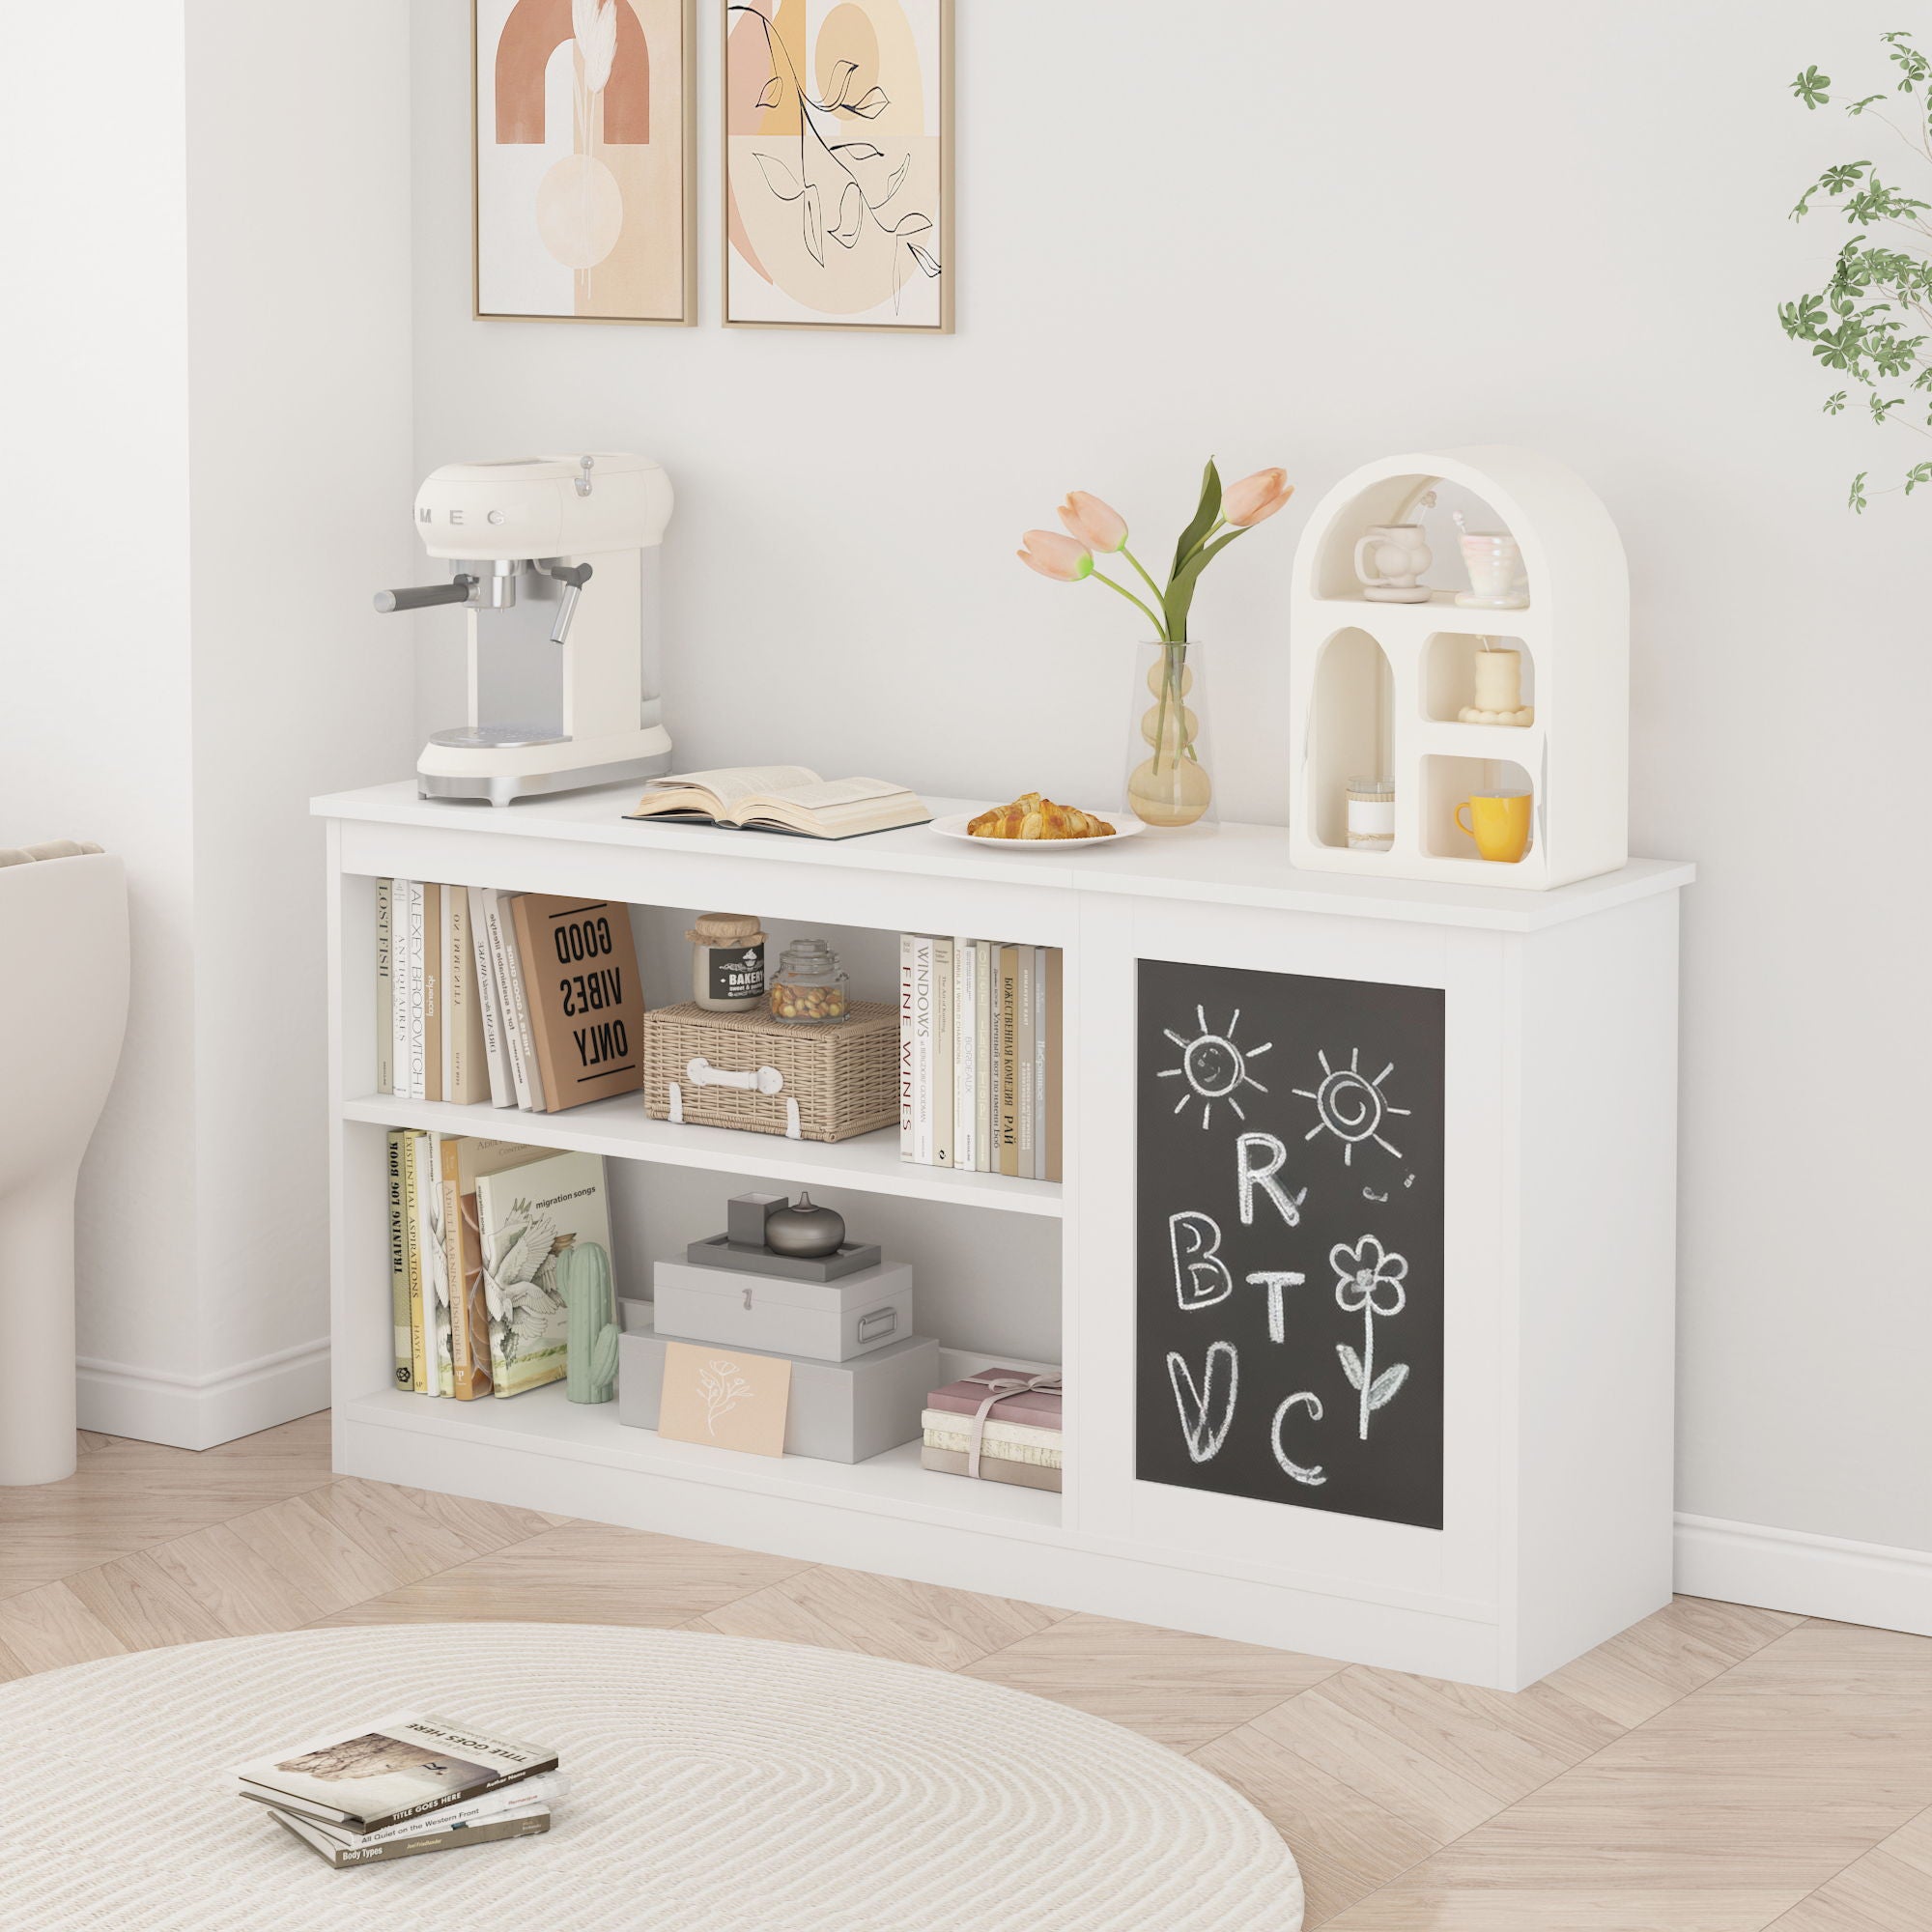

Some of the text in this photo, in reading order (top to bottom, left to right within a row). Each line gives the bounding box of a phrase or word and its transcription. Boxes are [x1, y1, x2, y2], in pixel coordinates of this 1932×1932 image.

[412, 507, 505, 526] MEG
[379, 886, 388, 977] LOST FISH
[411, 888, 422, 961] ALEXEY
[397, 935, 406, 1041] ANTIQUAIRES
[728, 970, 763, 985] BAKERY
[917, 945, 929, 1037] WINDOWS
[411, 966, 423, 1085] BRODOVITCH
[902, 966, 912, 1130] FINE WINES
[965, 1036, 974, 1094] BORDEAUX
[1004, 977, 1016, 1145] БОЖЕСТВЕННАЯ КОМЕДИЯ РАЙ
[389, 1142, 403, 1274] TRAINING LOG BOOK
[445, 1187, 455, 1226] ADULT
[535, 1185, 596, 1209] migration songs
[1237, 1132, 1300, 1227] R
[406, 1136, 422, 1359] EXISTENTIAL ASPIRATIONS HAYES
[447, 1229, 458, 1295] LEARNING
[1169, 1210, 1233, 1310] B
[451, 1295, 463, 1363] DISORDERS
[1246, 1270, 1305, 1343] T
[1271, 1392, 1326, 1485] C
[405, 1722, 446, 1737] HERE
[445, 1735, 490, 1750] GOES
[488, 1747, 527, 1762] TITLE
[392, 1792, 462, 1821] TITLE GOES HERE
[486, 1771, 526, 1788] Author Name
[342, 1847, 384, 1861] Body Types
[361, 1835, 372, 1844] All
[374, 1831, 396, 1840] Quiet
[410, 1823, 423, 1832] the
[425, 1813, 457, 1828] Western
[459, 1808, 480, 1820] Front
